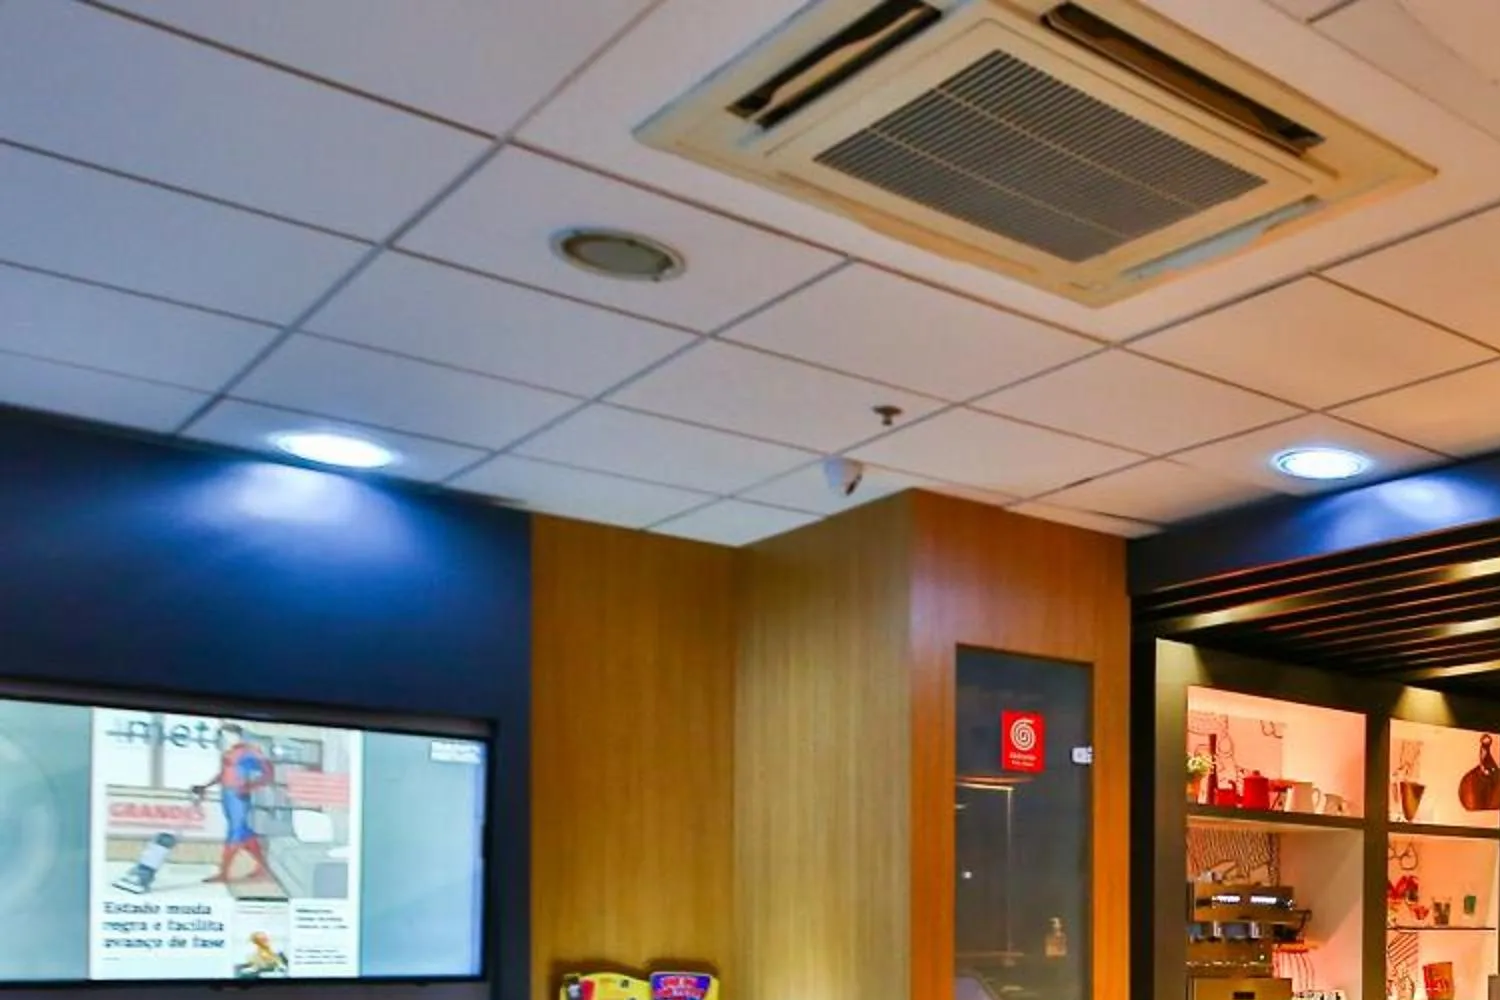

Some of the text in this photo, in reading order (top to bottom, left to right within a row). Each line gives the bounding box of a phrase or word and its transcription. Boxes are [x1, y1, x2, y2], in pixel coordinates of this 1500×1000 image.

[103, 902, 212, 916] Estado muda
[103, 919, 225, 935] regra e facilita
[103, 936, 226, 951] avanço de fase
